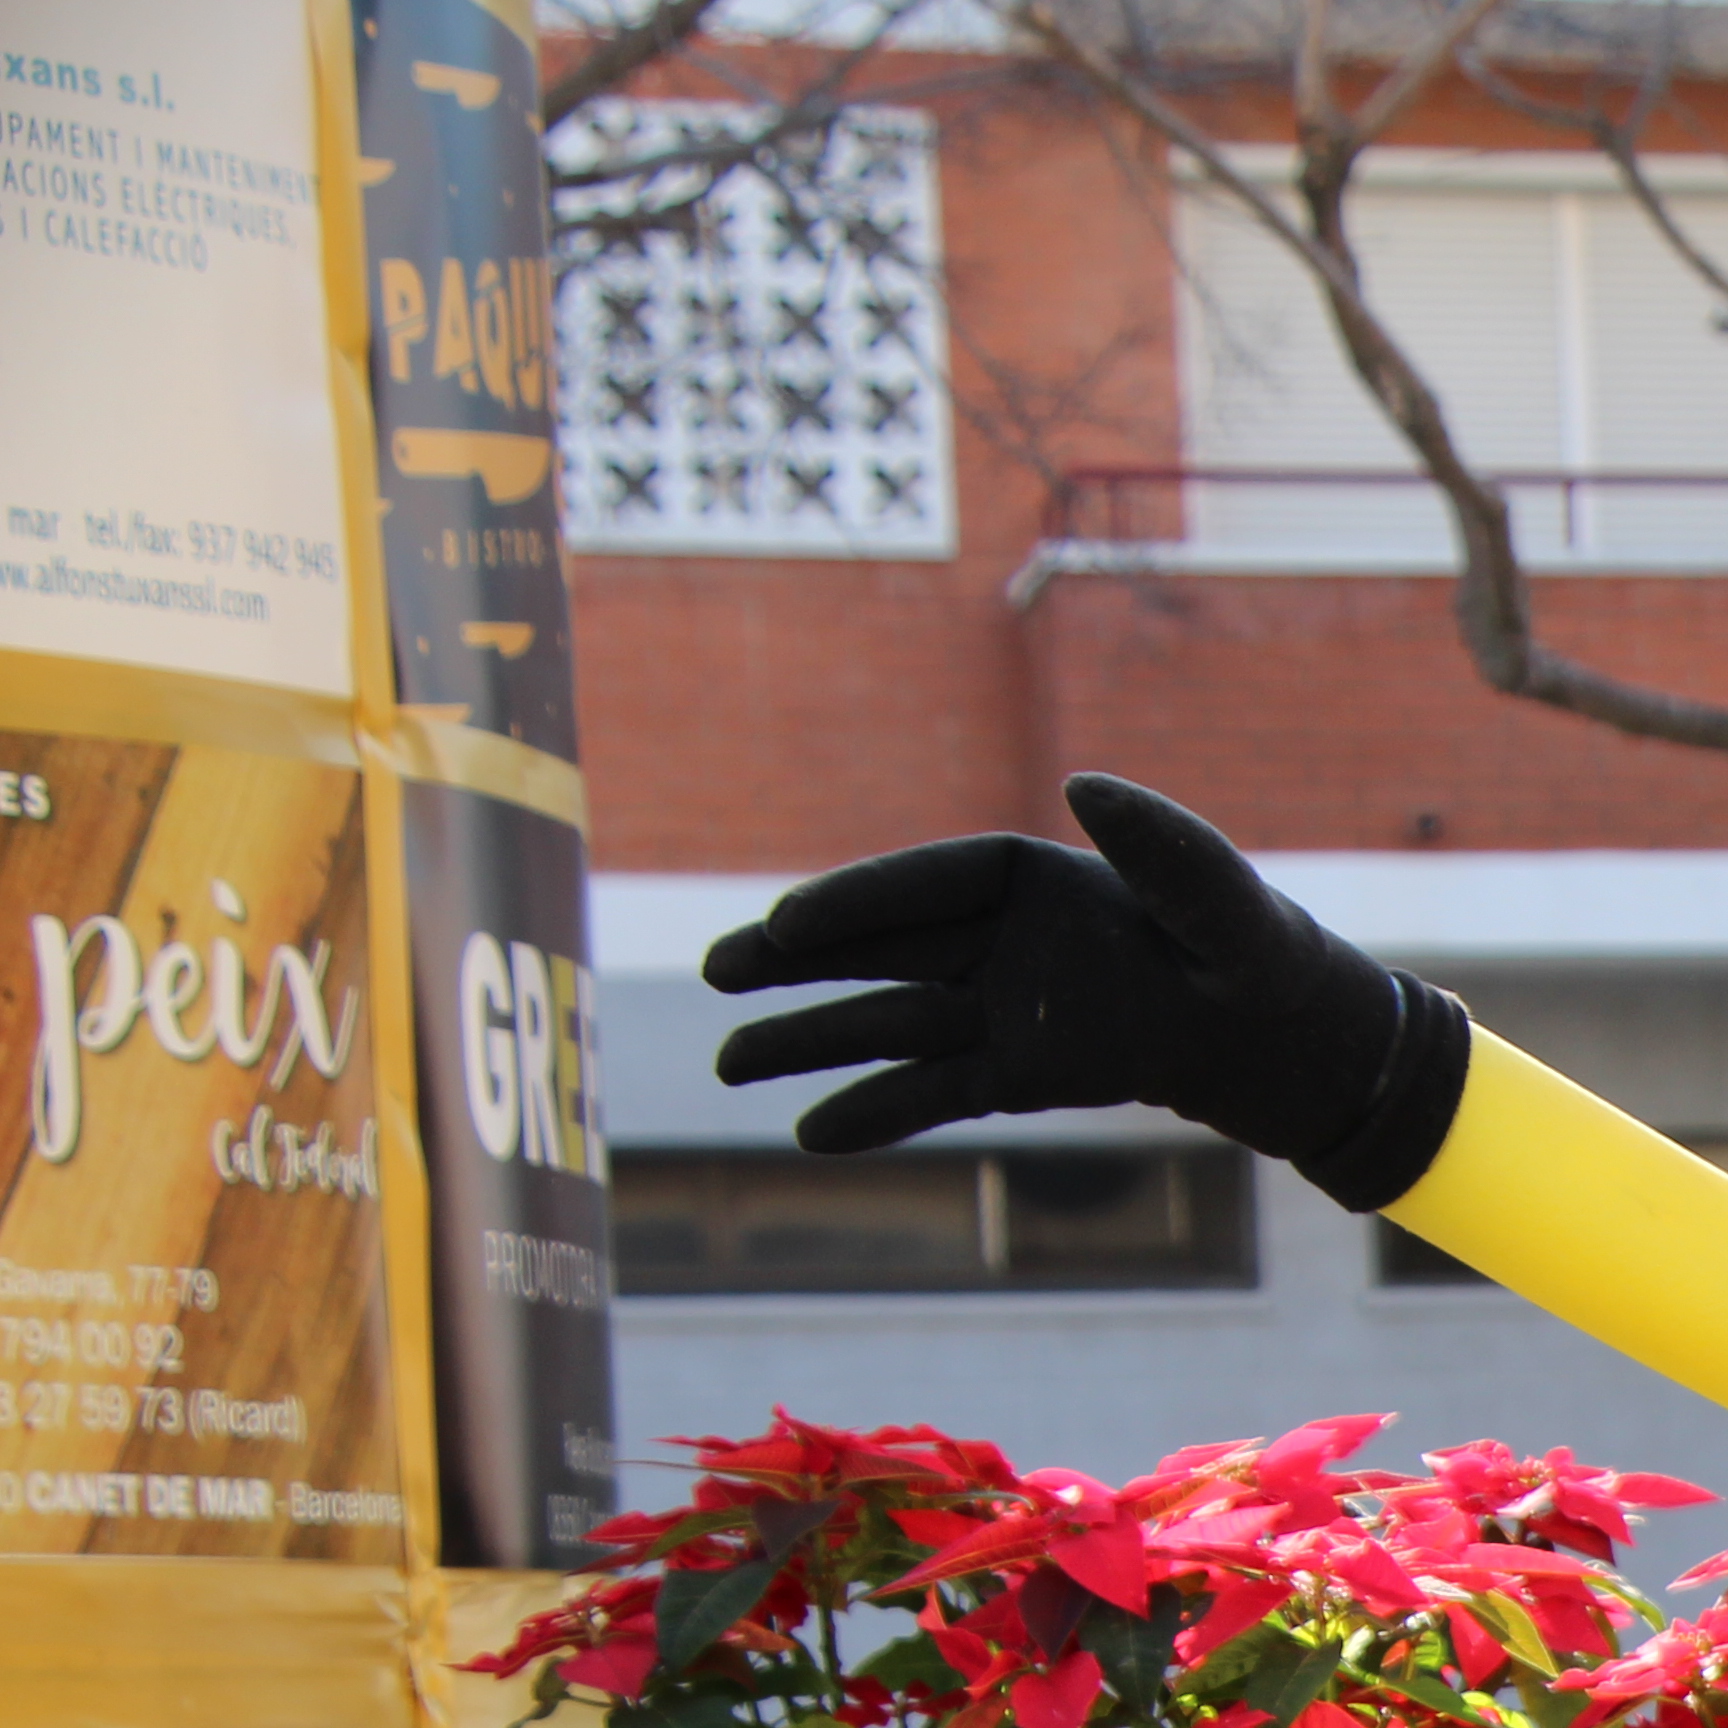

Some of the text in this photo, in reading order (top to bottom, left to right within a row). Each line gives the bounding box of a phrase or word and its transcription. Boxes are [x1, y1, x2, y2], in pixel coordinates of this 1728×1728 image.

[118, 70, 175, 113] s.l.
[0, 110, 119, 165] PAMENT
[8, 505, 60, 541] mar
[187, 519, 238, 564] 937
[243, 528, 290, 576] 942
[30, 877, 360, 1167] peix
[127, 1264, 220, 1313] 77-79
[77, 1319, 131, 1369] 00
[135, 1322, 186, 1374] 92
[23, 1380, 73, 1430] 27
[78, 1382, 131, 1433] 59
[134, 1385, 186, 1437] 73
[188, 1386, 308, 1446] (Ricard)
[25, 1470, 142, 1519] CANET
[145, 1474, 196, 1521] DE
[198, 1476, 275, 1523] MAR
